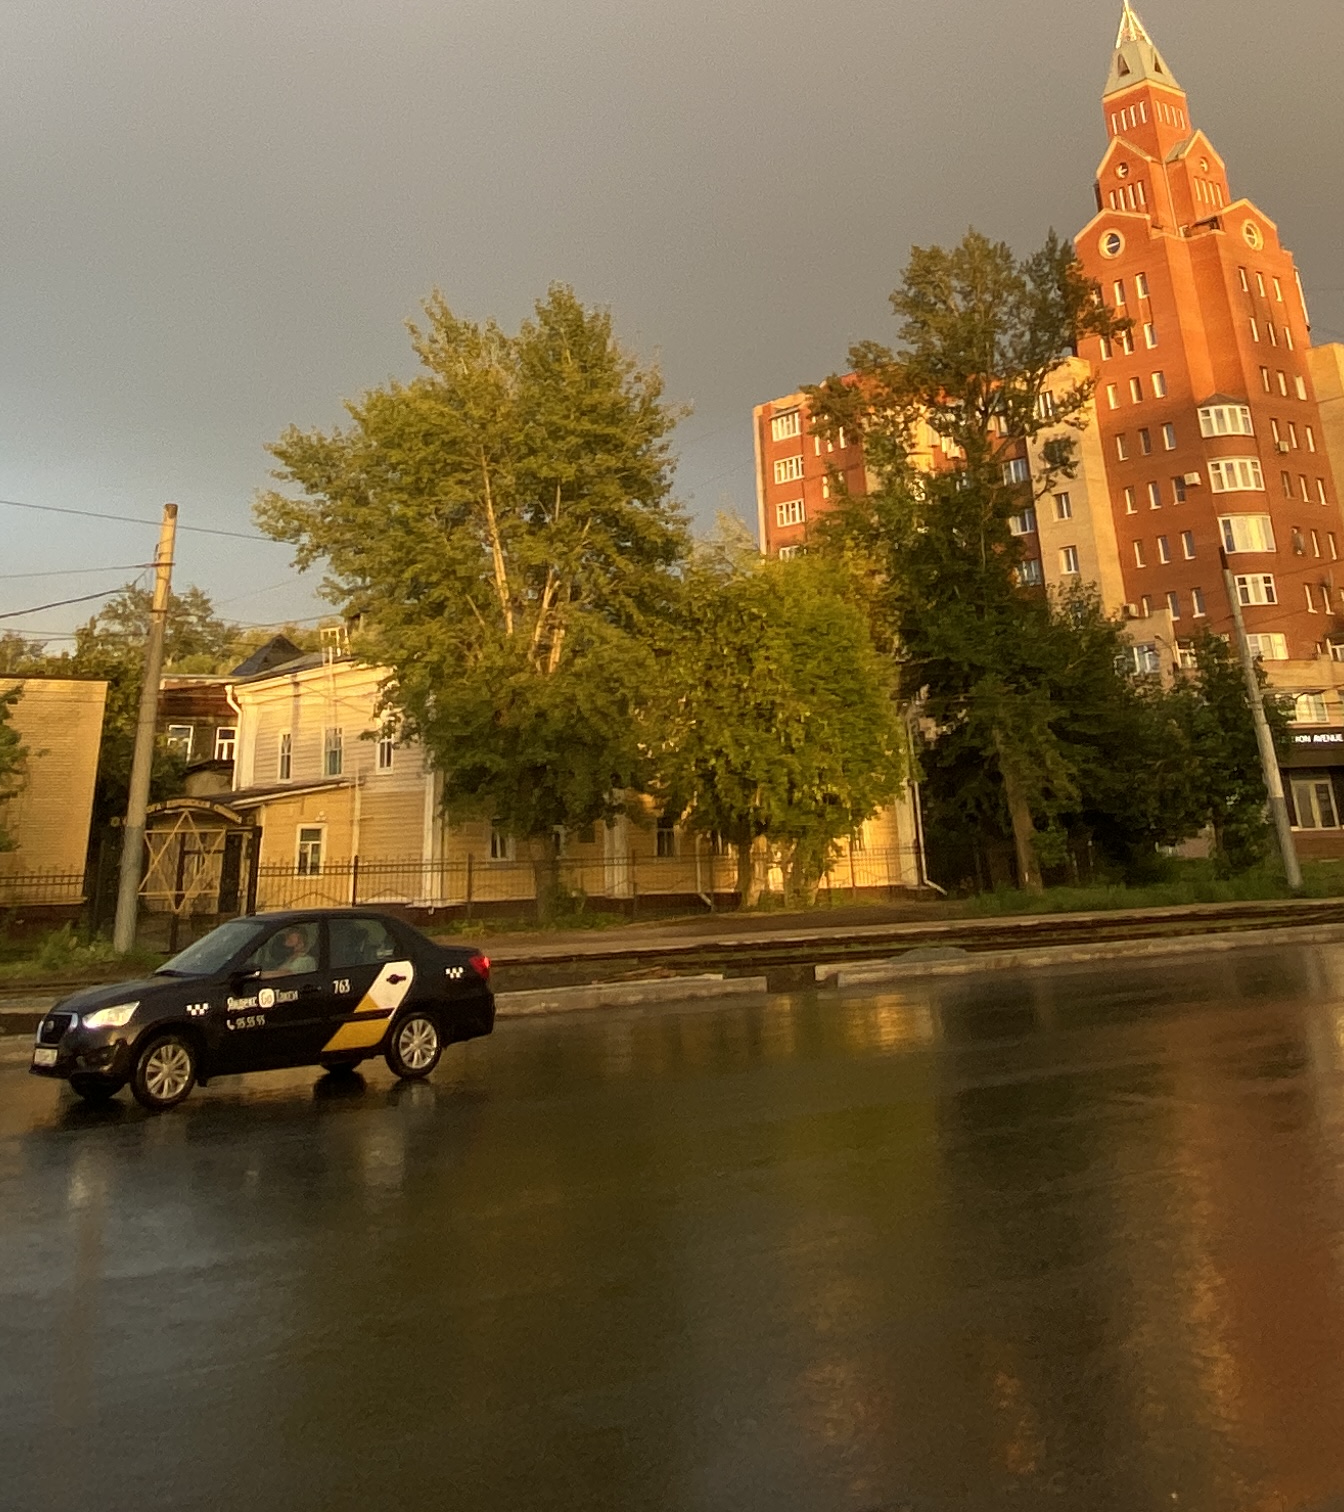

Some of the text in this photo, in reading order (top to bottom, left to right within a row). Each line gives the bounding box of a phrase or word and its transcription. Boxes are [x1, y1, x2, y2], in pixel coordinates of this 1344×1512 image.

[1313, 733, 1344, 743] AVENUE
[332, 978, 351, 994] 763
[227, 996, 258, 1011] Яндекс
[275, 989, 299, 1003] Такси
